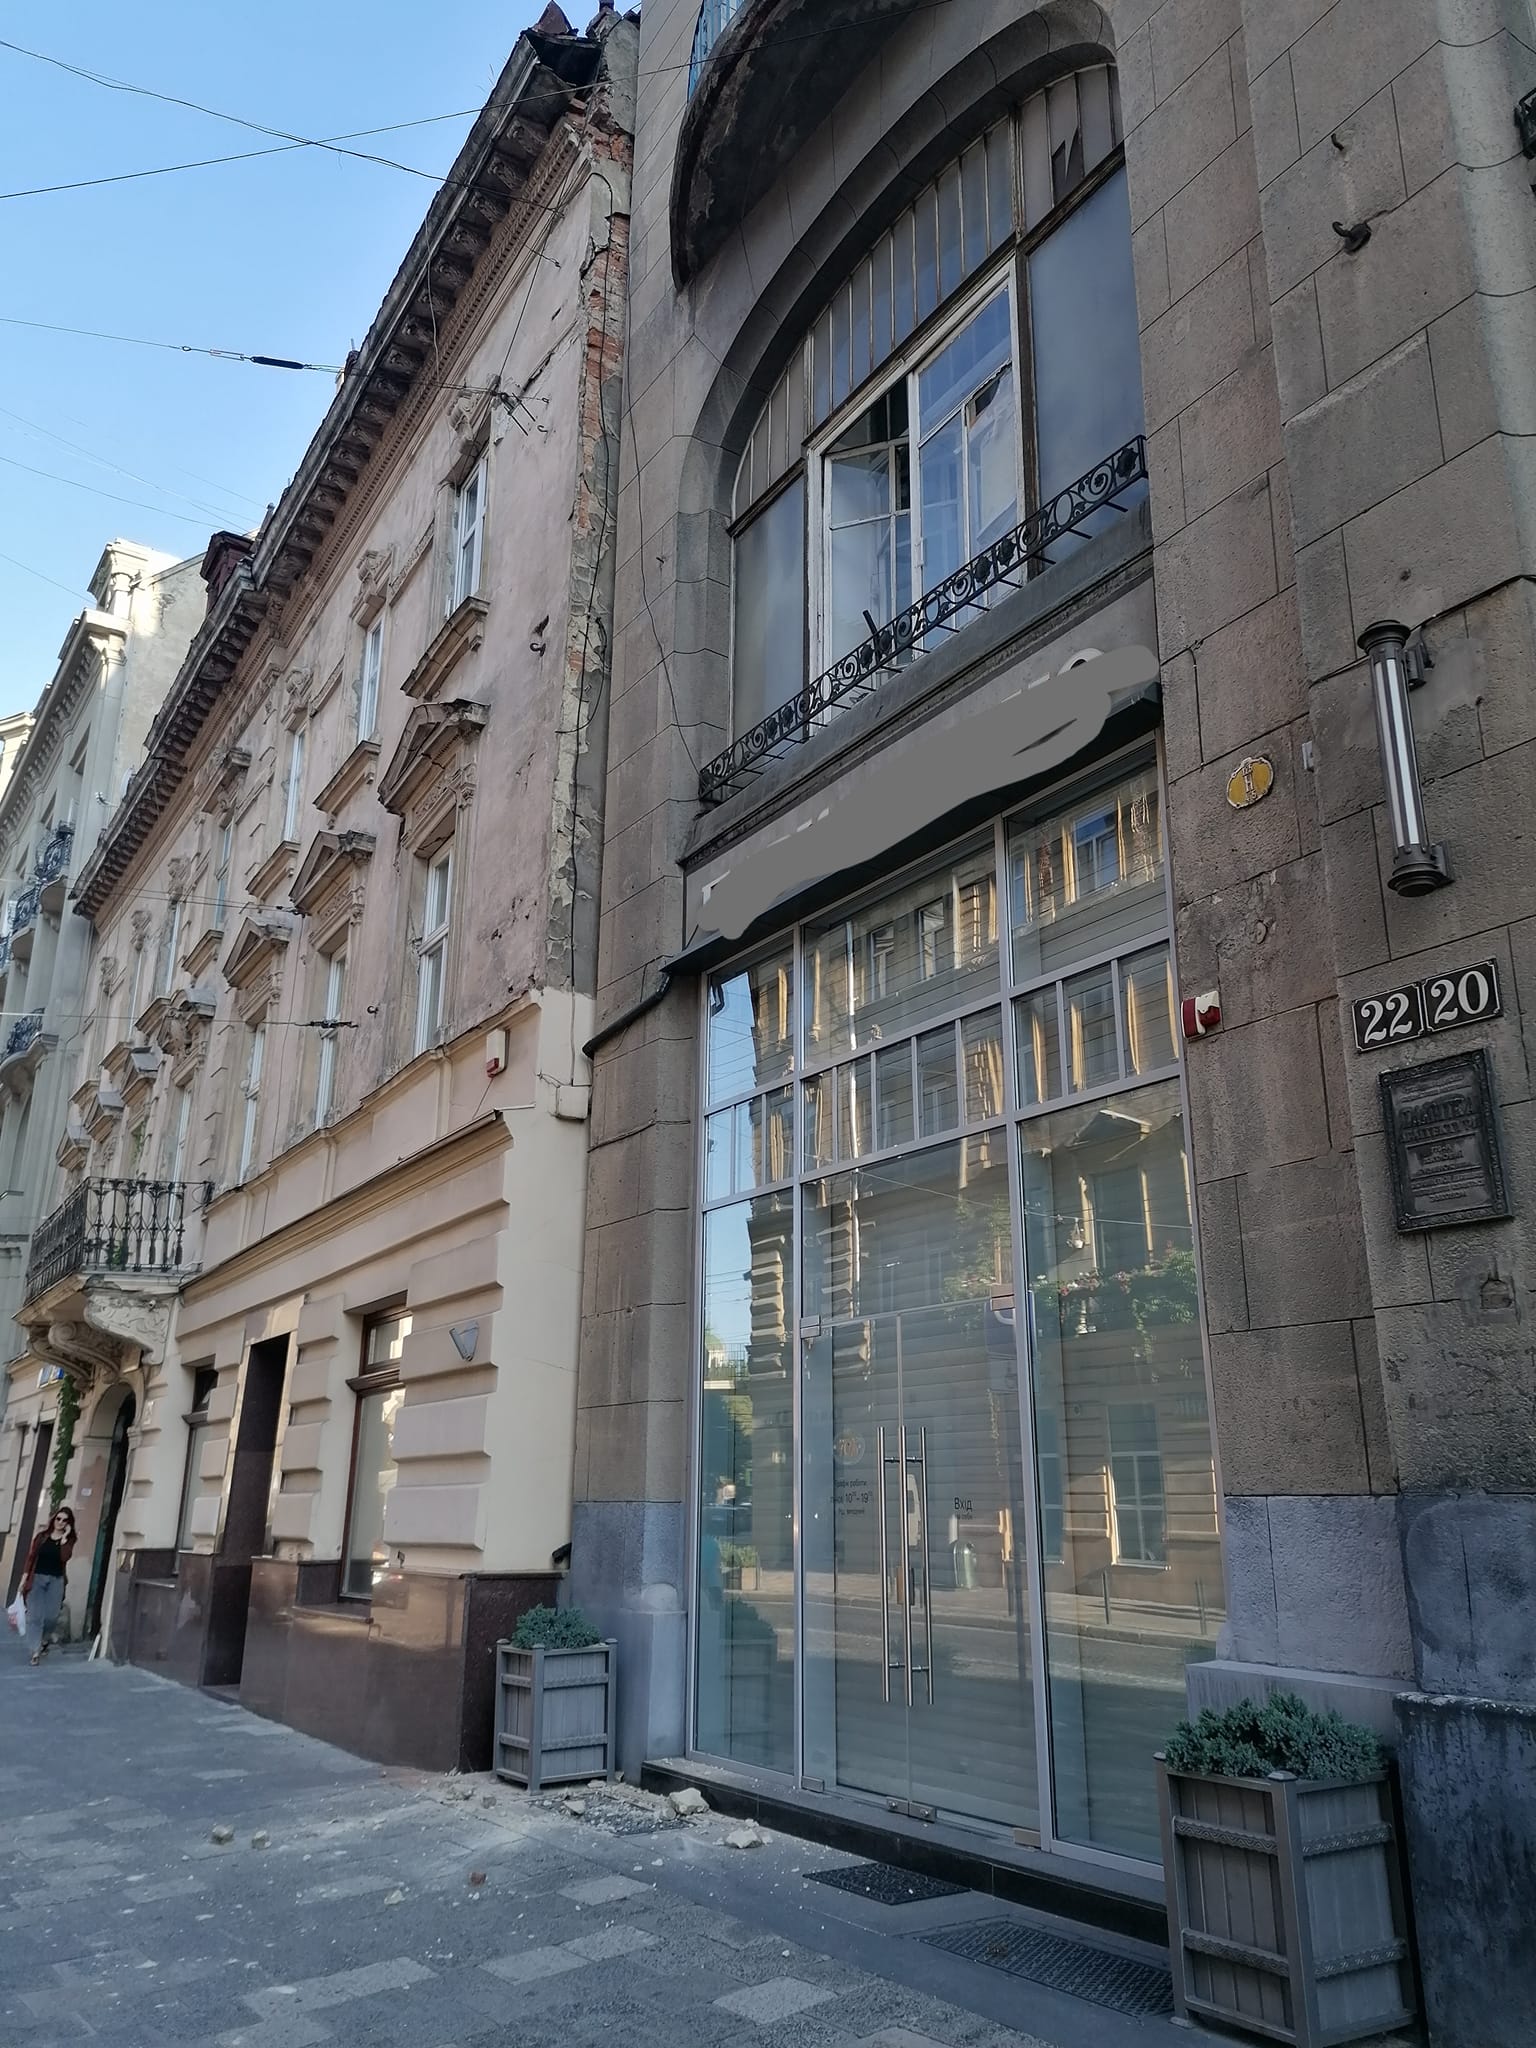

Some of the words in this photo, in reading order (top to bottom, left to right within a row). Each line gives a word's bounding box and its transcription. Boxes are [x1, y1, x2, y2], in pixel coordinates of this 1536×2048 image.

[1361, 993, 1413, 1044] 22
[1431, 970, 1489, 1024] 20
[954, 1497, 973, 1512] Вхід
